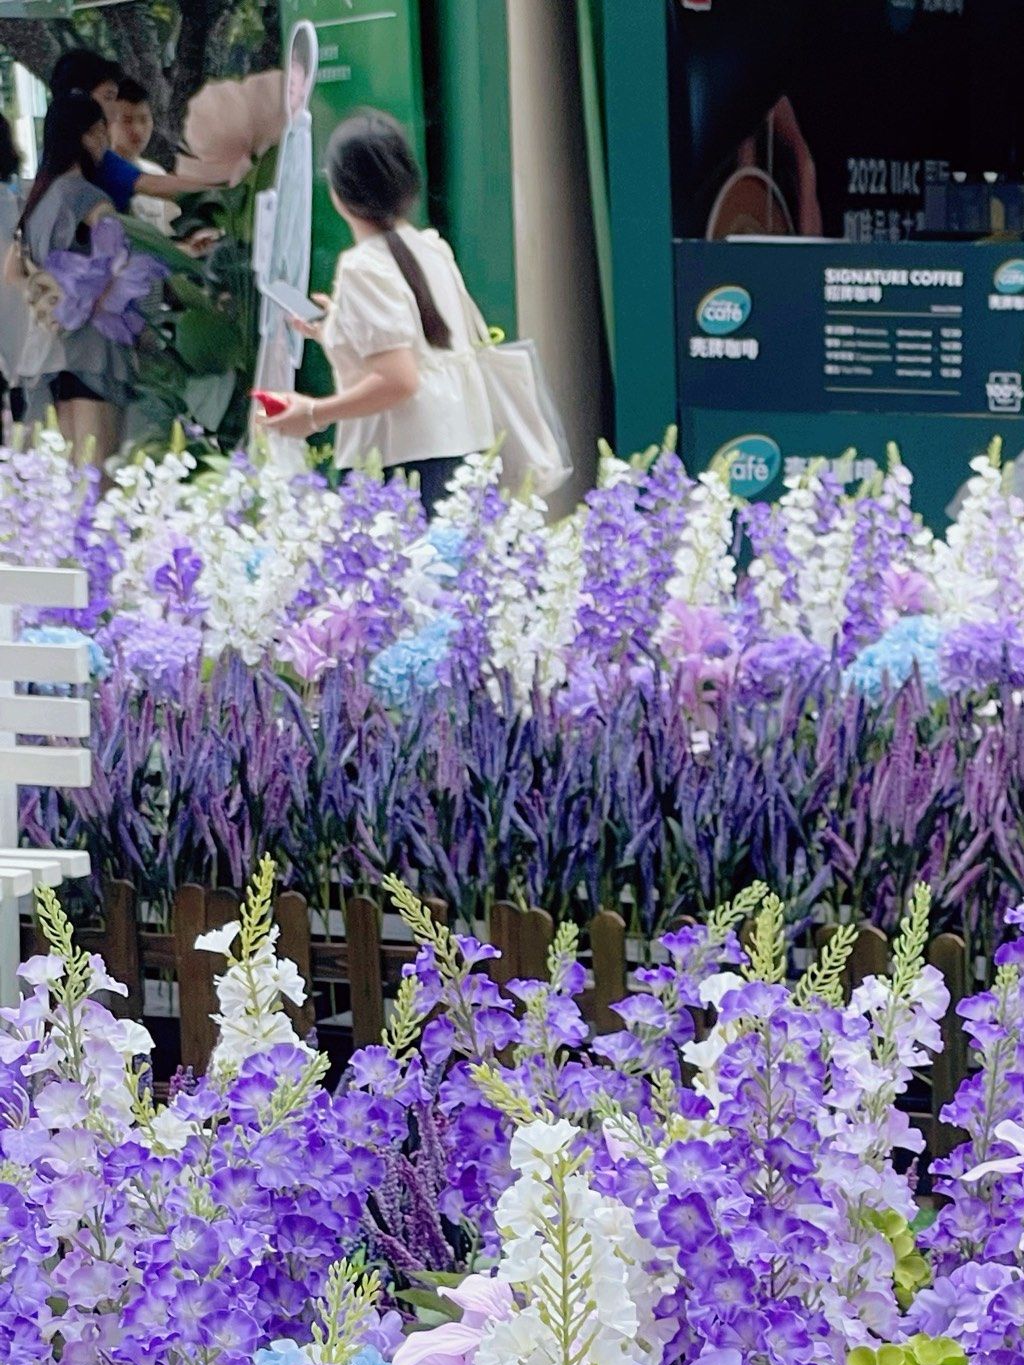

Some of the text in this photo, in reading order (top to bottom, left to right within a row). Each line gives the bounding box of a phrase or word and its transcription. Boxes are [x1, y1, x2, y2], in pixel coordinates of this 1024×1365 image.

[847, 158, 887, 194] 2022
[824, 268, 963, 287] SIGNATURE COFFEE
